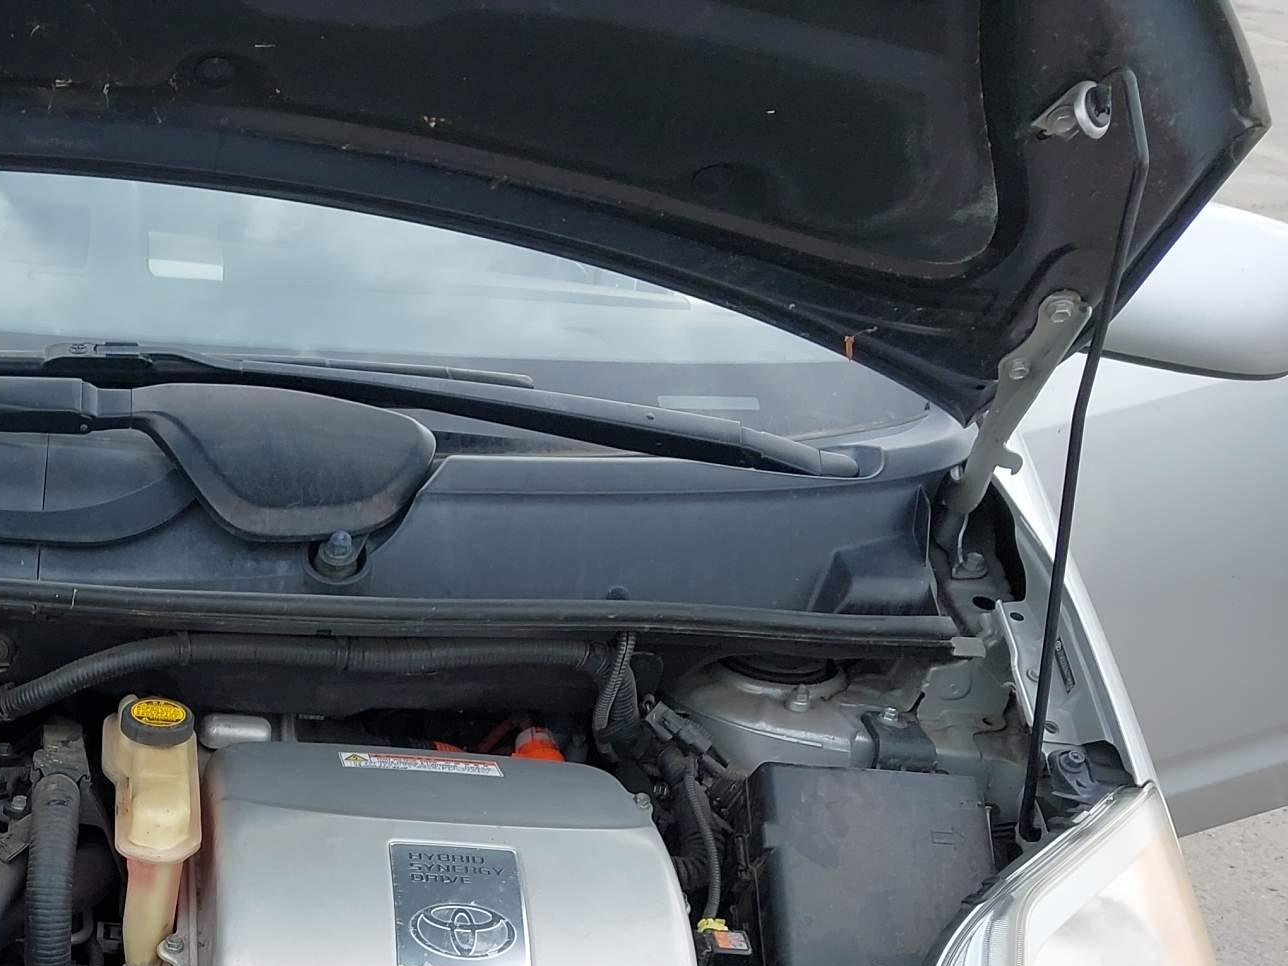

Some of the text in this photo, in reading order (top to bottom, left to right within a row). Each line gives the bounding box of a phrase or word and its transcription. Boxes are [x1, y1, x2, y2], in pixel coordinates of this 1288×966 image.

[408, 852, 485, 864] HYBRID
[409, 862, 504, 876] SYNERGY
[410, 873, 472, 884] DRIVE
